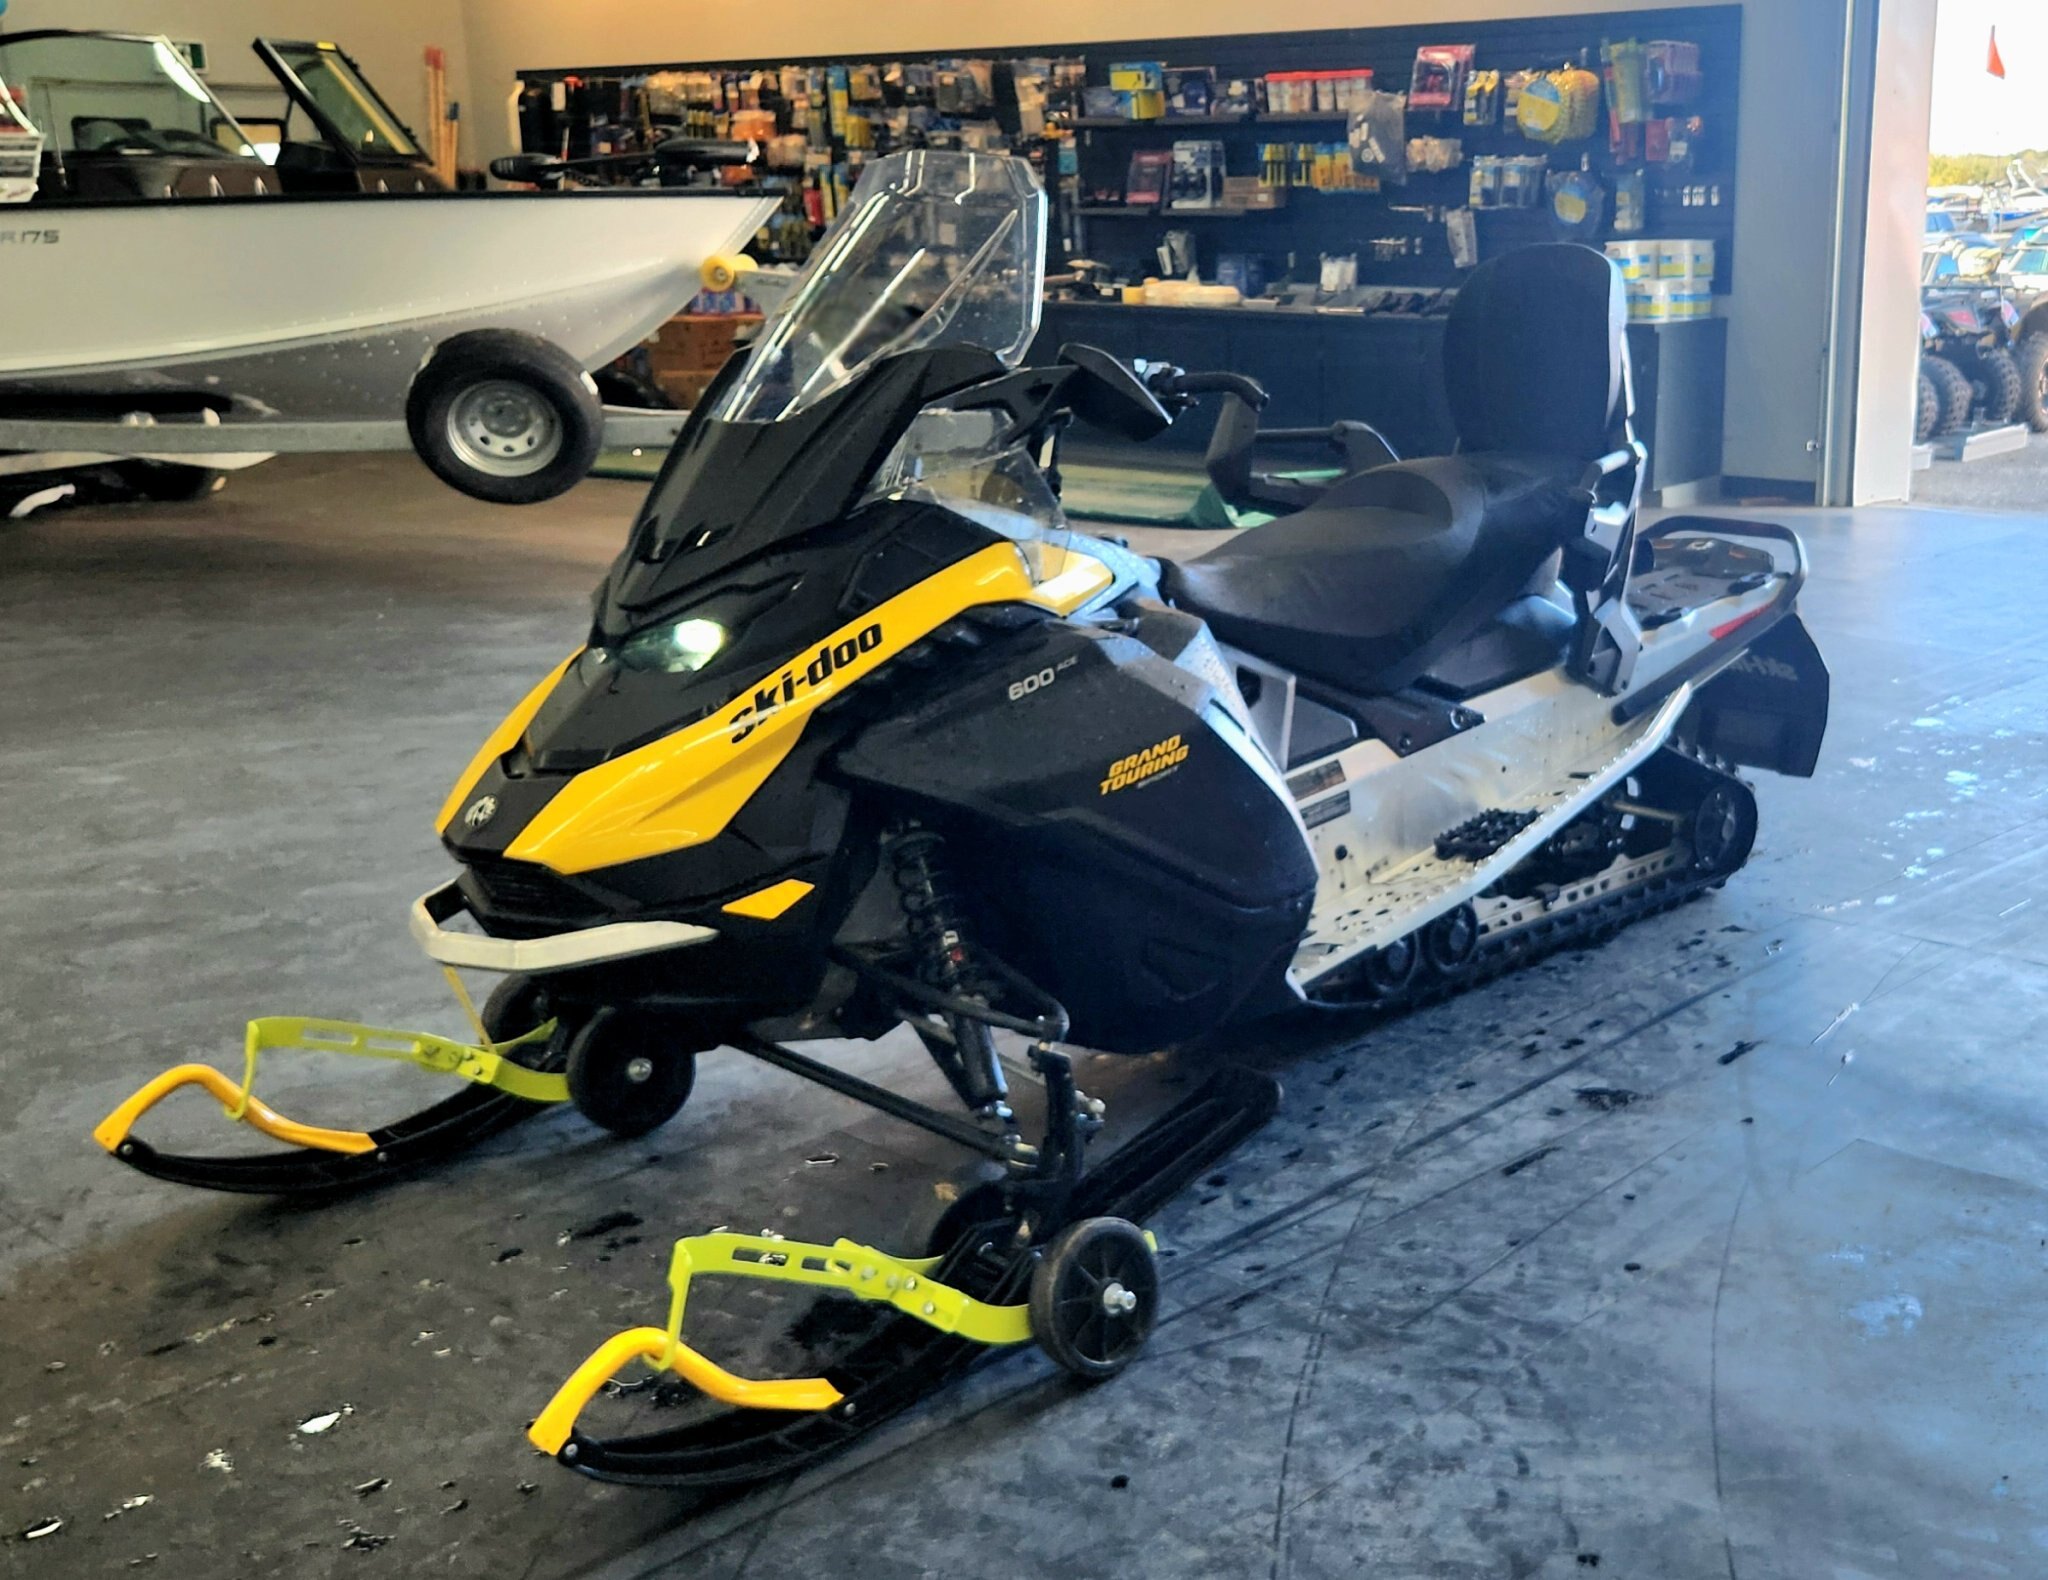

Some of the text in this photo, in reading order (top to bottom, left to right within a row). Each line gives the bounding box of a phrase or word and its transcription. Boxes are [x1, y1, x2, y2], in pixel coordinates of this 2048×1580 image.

[1008, 667, 1055, 701] 600
[1100, 744, 1190, 795] TOURING
[1108, 734, 1181, 778] GRAND
